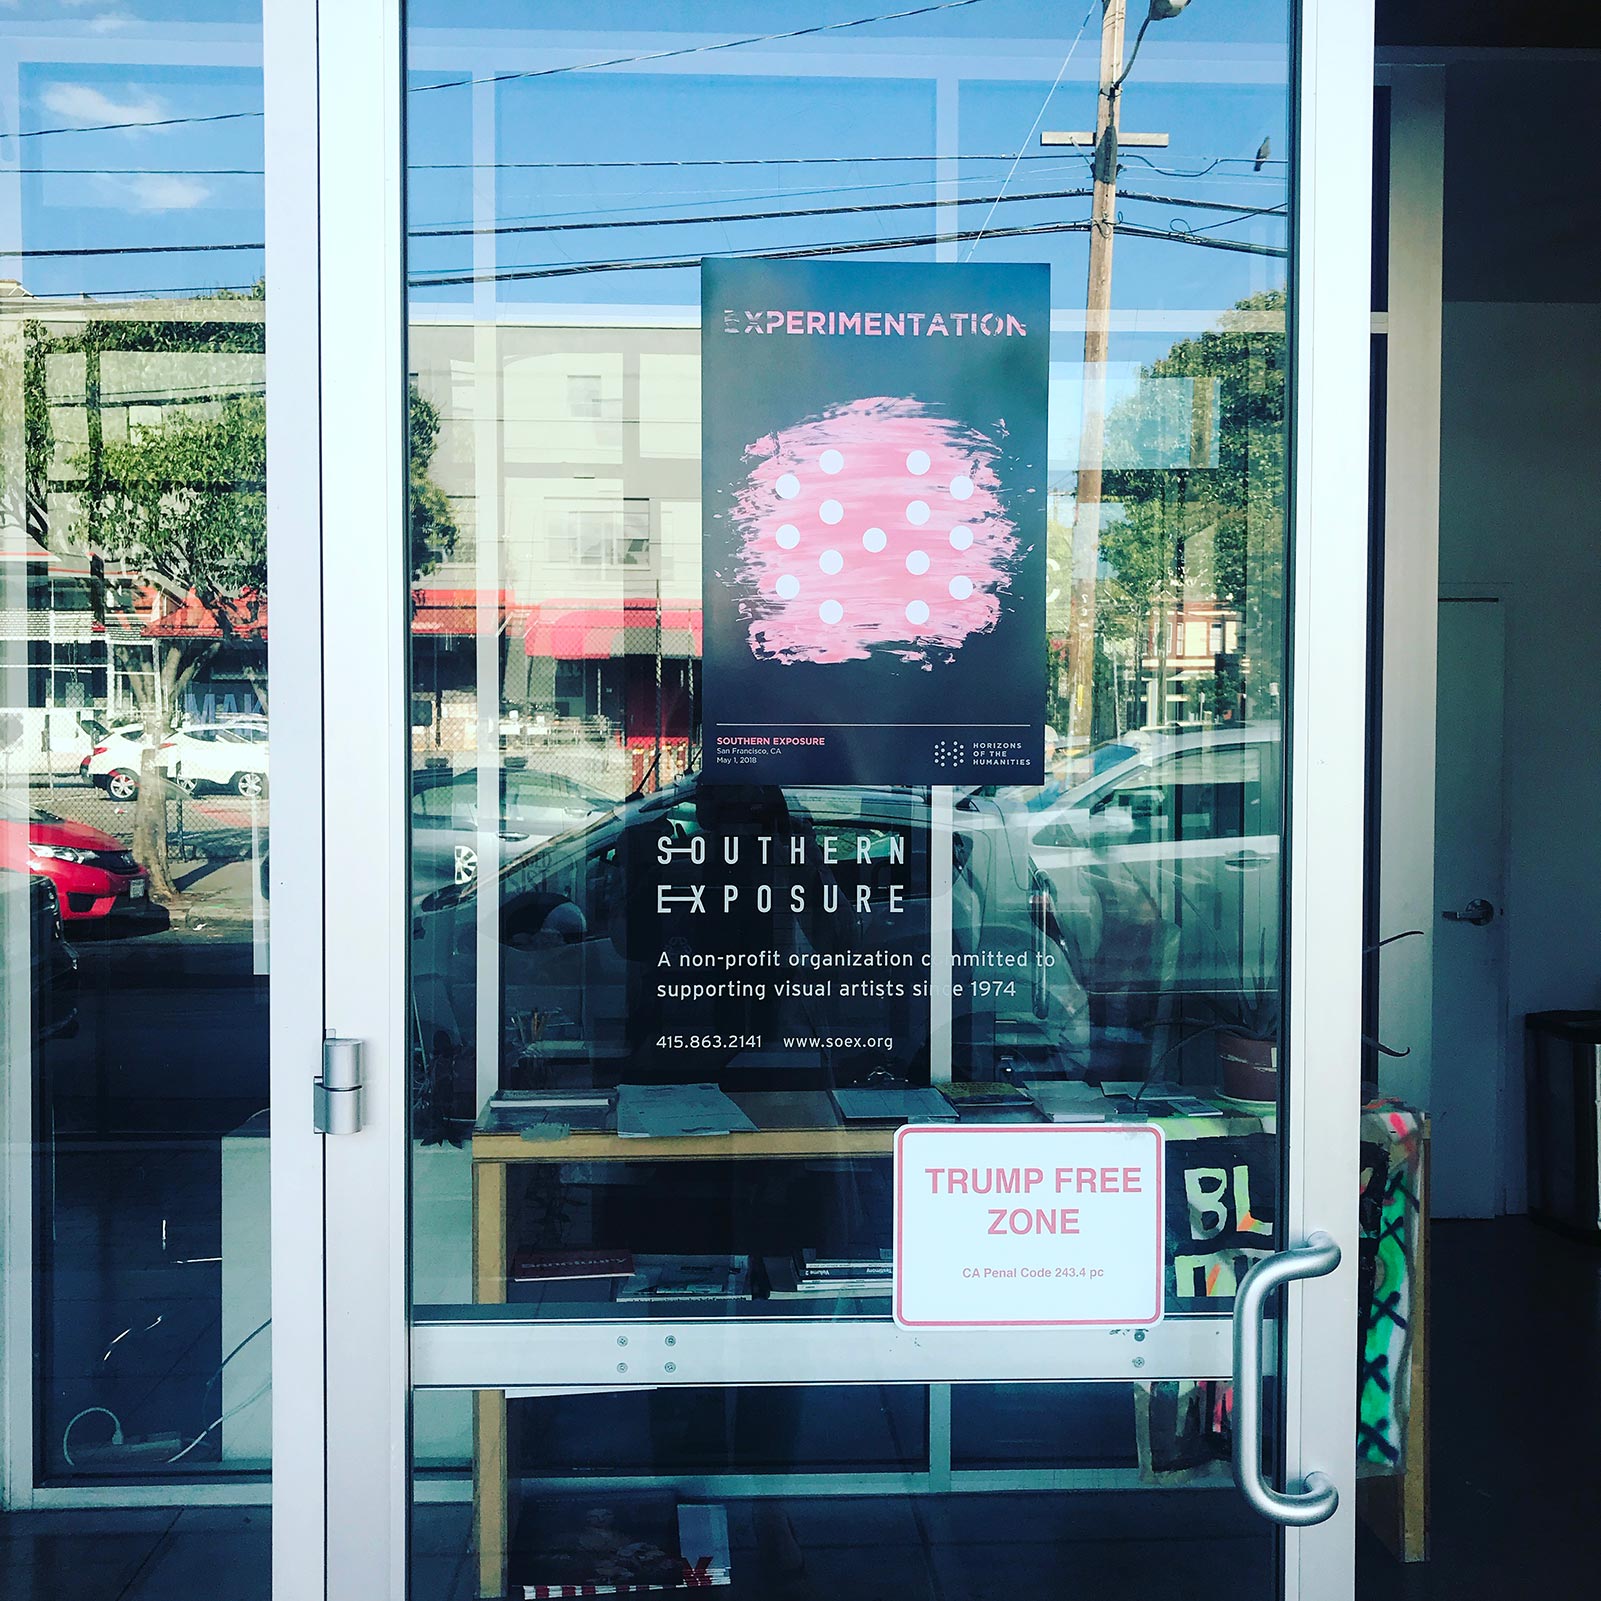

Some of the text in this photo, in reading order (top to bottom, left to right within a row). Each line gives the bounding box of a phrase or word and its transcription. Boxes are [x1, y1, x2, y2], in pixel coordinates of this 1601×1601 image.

[723, 309, 1028, 336] EXPERIMENTATION
[716, 737, 826, 746] SOUTHERN EXPOSURE
[716, 747, 782, 756] San Francisco, CA
[716, 756, 732, 765] May
[733, 757, 738, 765] 1,
[657, 836, 904, 865] SOUTHERN
[657, 884, 904, 914] EXPOSURE
[657, 950, 1055, 970] A non-profit organization cmmitted to
[656, 980, 766, 1000] supporting
[774, 980, 831, 997] visual
[839, 980, 905, 997] artists
[970, 981, 1017, 997] 1974
[656, 1035, 893, 1050] 415.863.2141 www.soex.org
[924, 1167, 1142, 1194] TRUMP FREE
[987, 1208, 1080, 1235] ZONE
[962, 1267, 1104, 1280] CA Penal Code 243.4 pc
